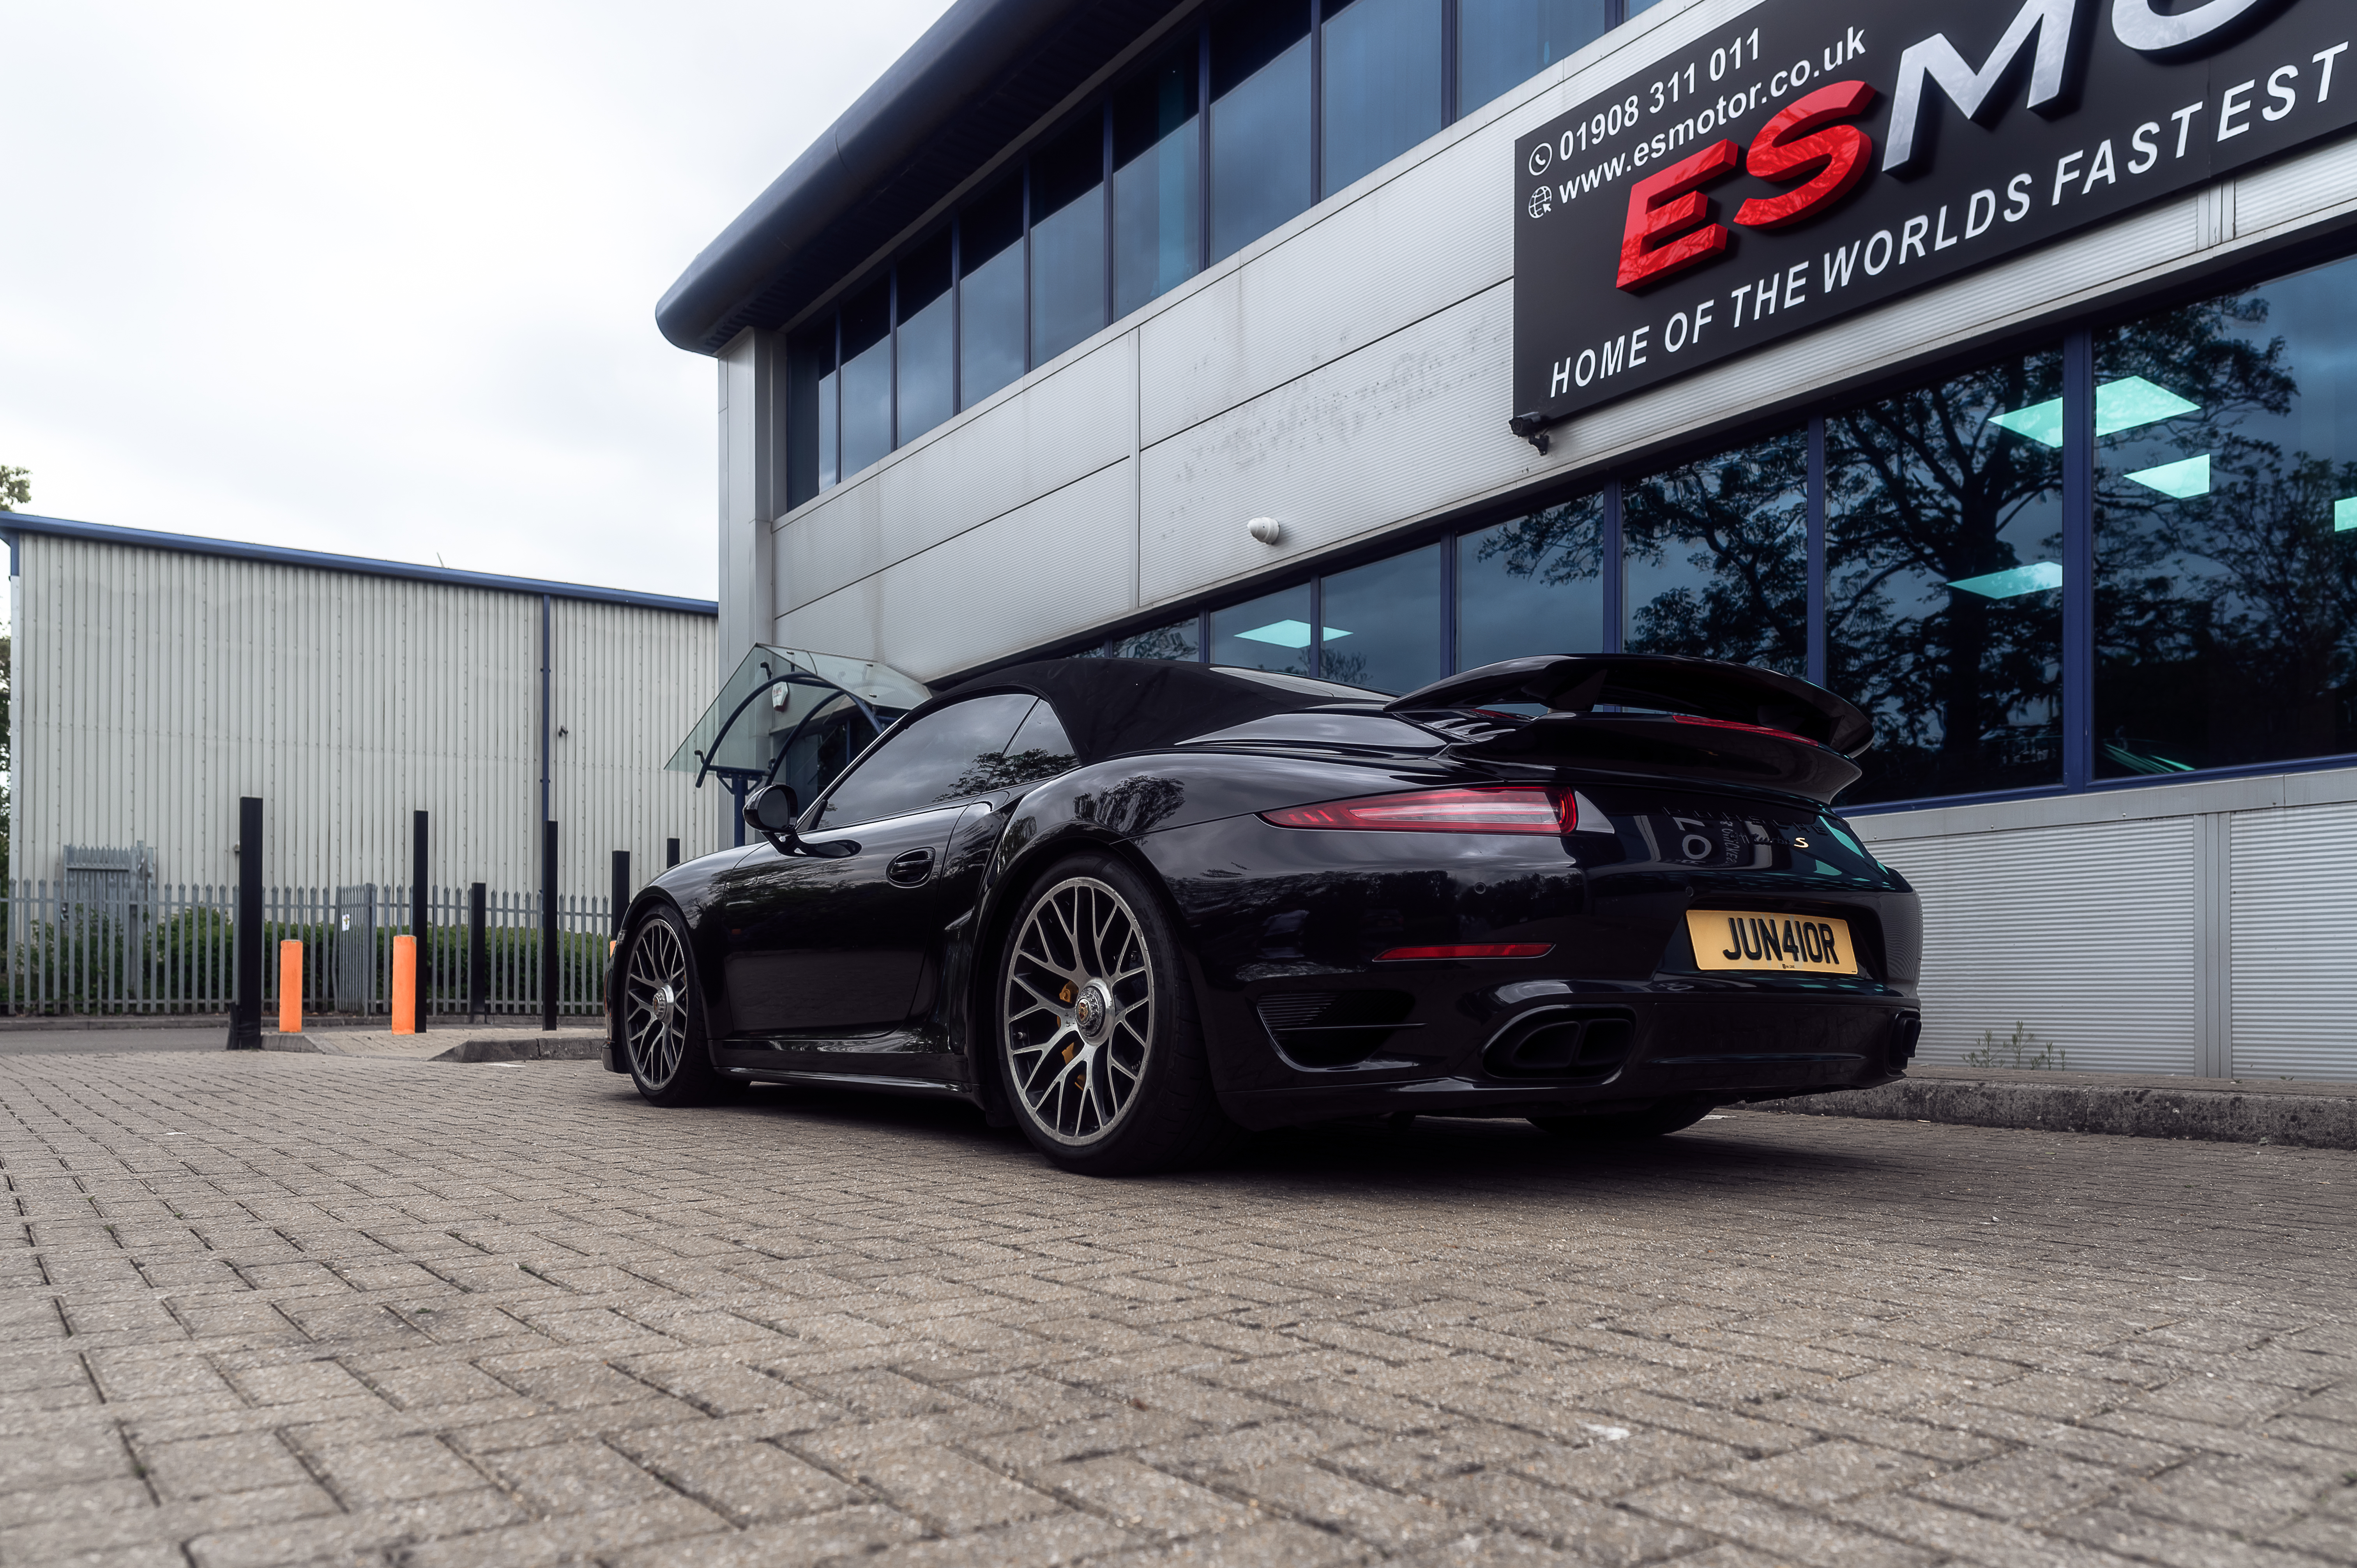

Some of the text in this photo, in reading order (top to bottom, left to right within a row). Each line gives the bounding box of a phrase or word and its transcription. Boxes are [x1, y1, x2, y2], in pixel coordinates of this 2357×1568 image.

[1559, 26, 1866, 204] www.esmotor.co.uk
[1560, 27, 1758, 161] 01908 311 011
[1550, 41, 2349, 398] HOME OF THE WORLDS FASTEST
[1662, 806, 1829, 836] PORSCHE
[1729, 831, 1750, 845] 911
[1793, 837, 1809, 848] S
